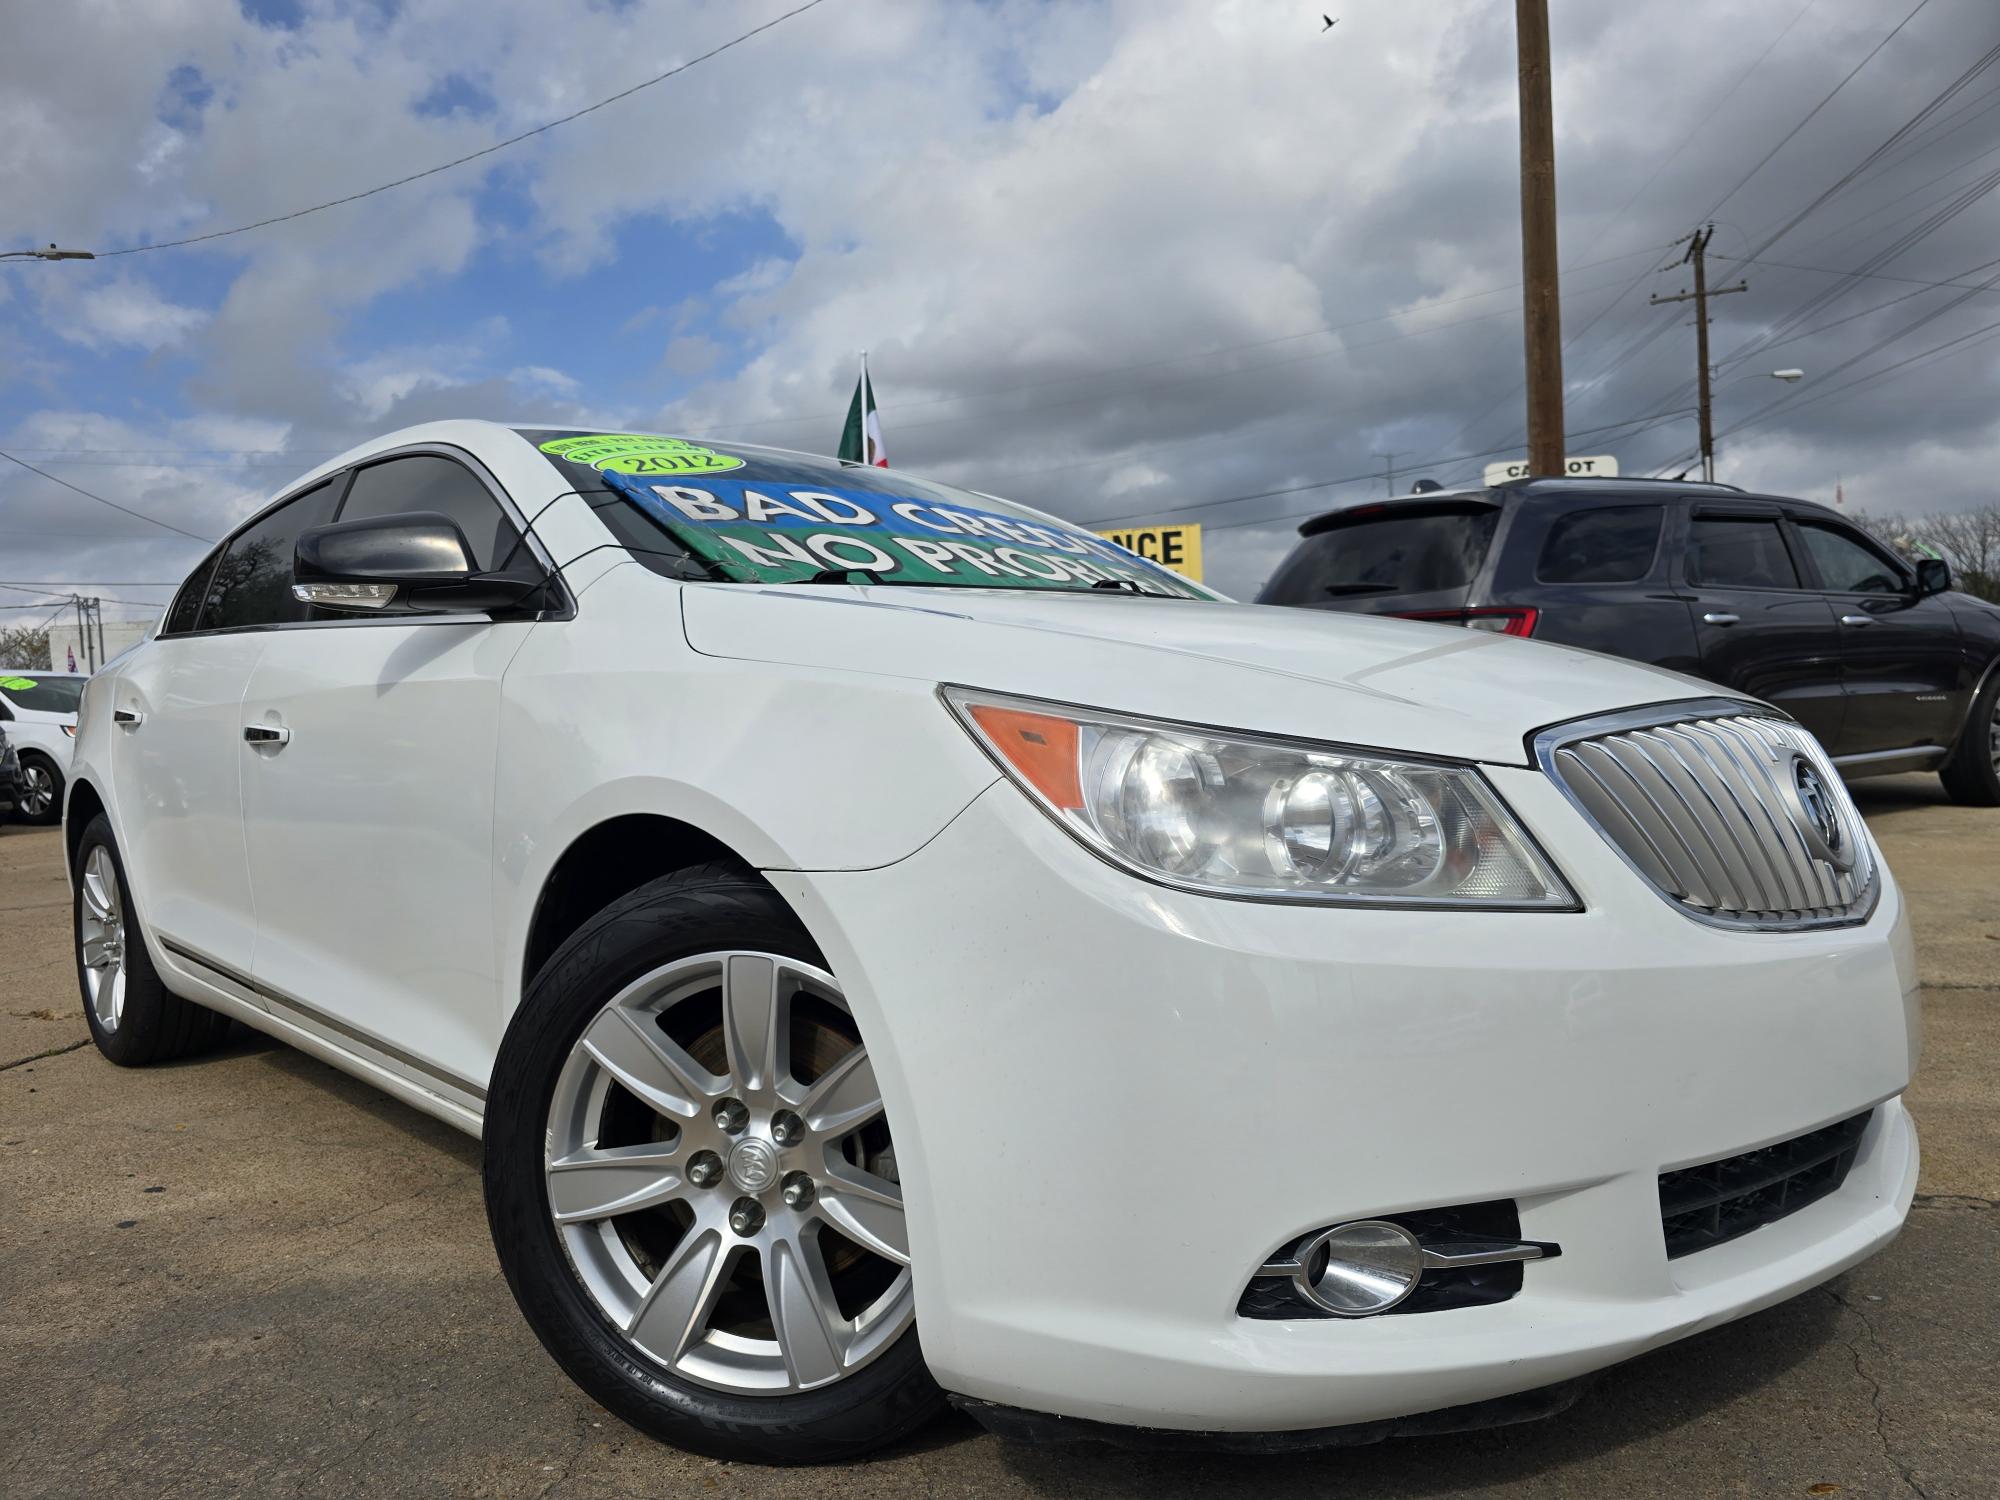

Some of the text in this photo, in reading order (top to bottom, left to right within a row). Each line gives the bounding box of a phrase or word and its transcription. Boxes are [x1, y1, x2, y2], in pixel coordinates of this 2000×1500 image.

[573, 446, 626, 461] EXTRA
[623, 454, 724, 473] 2012
[1507, 460, 1595, 478] CA OT
[650, 485, 877, 526] BAD
[718, 533, 896, 573] NO
